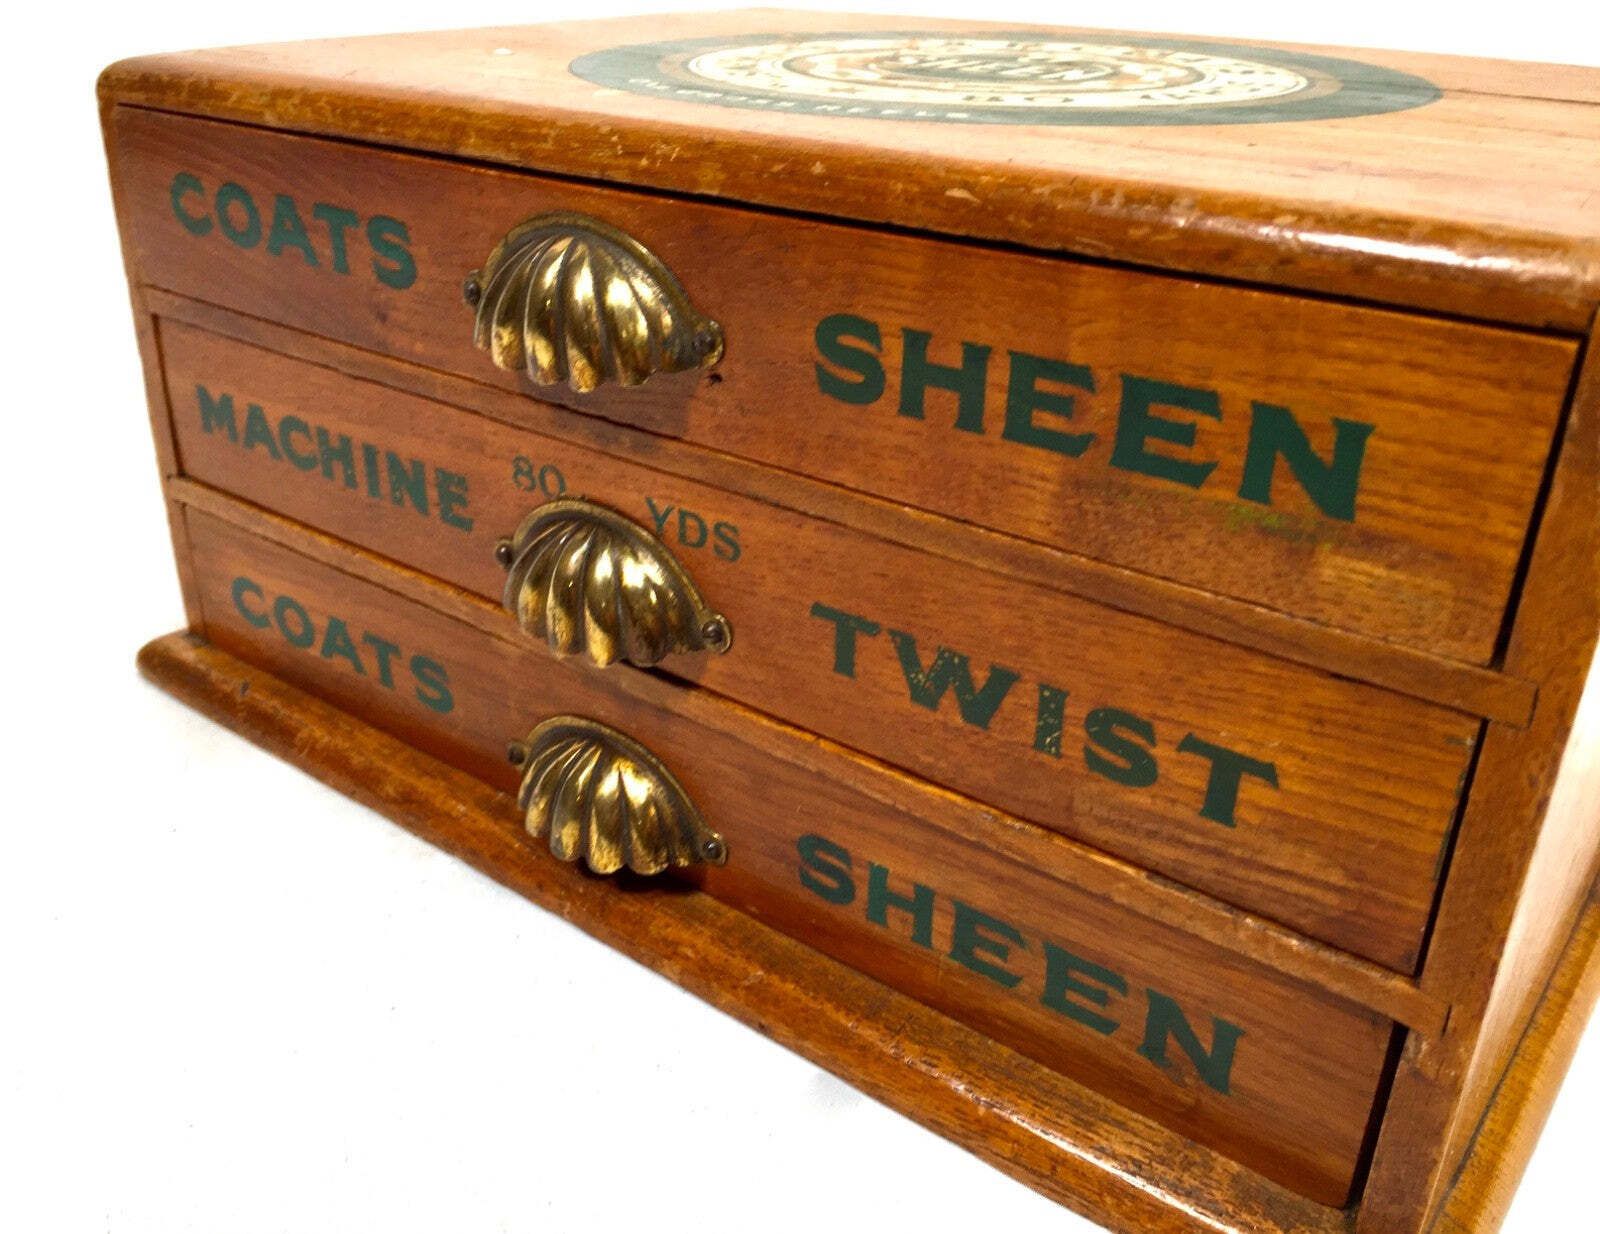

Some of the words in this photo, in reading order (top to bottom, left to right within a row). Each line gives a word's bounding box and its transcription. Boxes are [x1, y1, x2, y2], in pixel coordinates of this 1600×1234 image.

[169, 171, 418, 290] COATS
[813, 312, 1376, 524] SHEEN
[511, 454, 567, 499] 80
[645, 496, 742, 564] YDS
[195, 383, 474, 534] MACHINE
[809, 601, 1280, 829] TWIST
[231, 576, 456, 714] COATS
[795, 832, 1248, 1096] SHEEN
